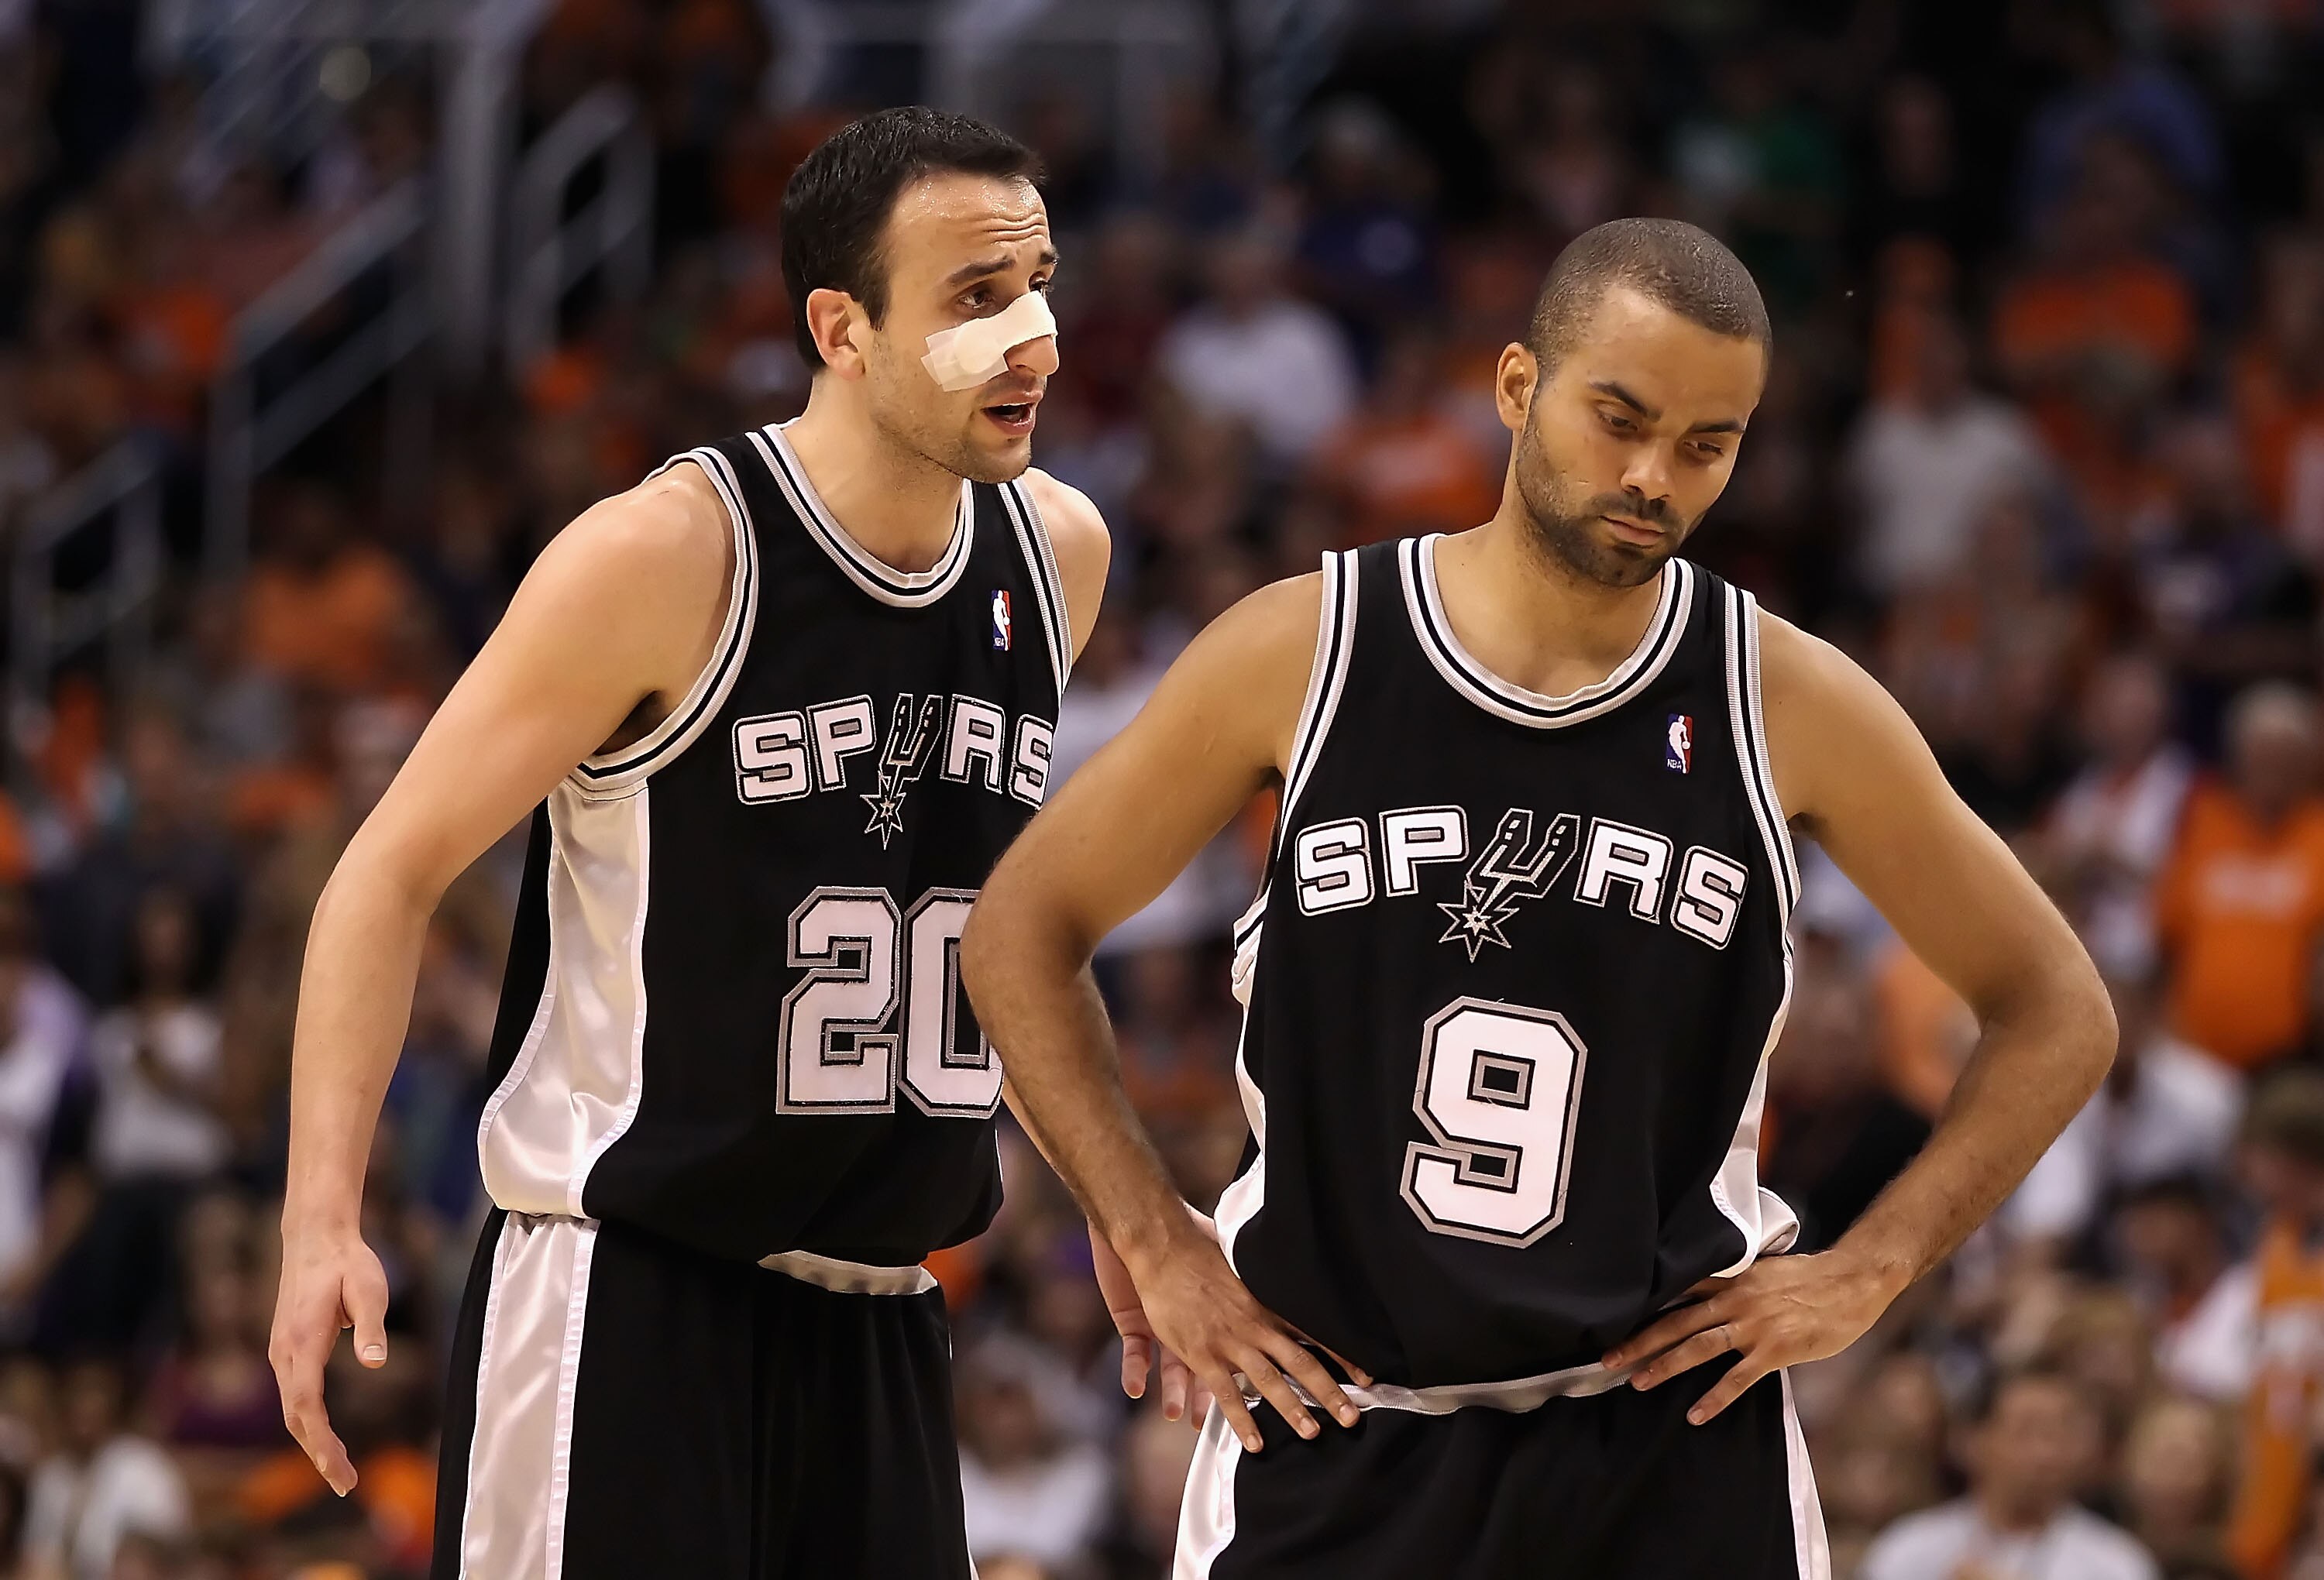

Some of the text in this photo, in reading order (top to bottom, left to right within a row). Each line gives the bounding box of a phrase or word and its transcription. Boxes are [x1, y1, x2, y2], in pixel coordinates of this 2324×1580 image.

[732, 694, 1054, 850] SPURS
[1667, 758, 1682, 770] NBA
[1295, 805, 1748, 963] SPURS
[775, 885, 1004, 1119] 20
[1399, 995, 1588, 1249] 9
